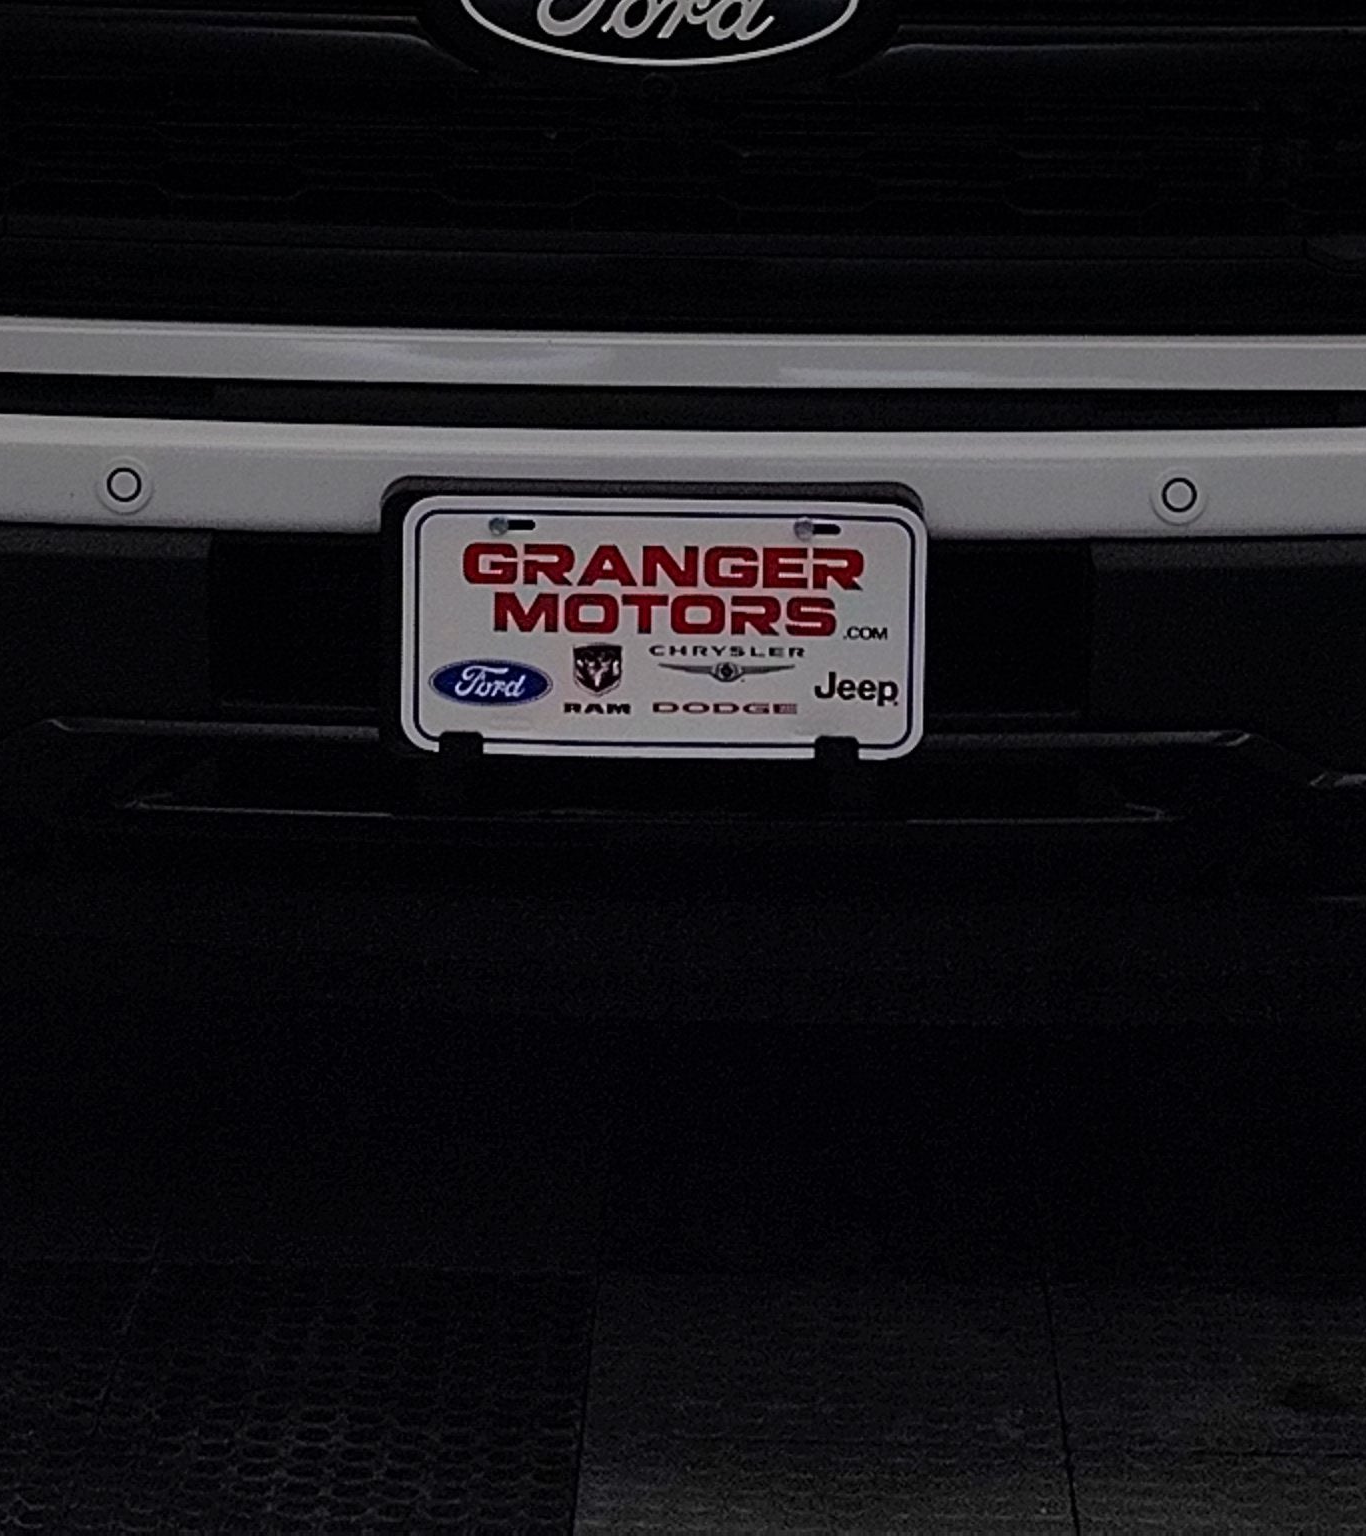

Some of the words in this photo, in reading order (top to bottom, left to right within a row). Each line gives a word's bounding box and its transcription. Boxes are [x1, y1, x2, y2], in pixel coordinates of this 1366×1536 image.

[462, 542, 865, 590] GRANGER
[493, 591, 837, 636] MOTORS
[843, 626, 888, 641] .COM
[648, 643, 805, 658] CHRYSLER
[454, 666, 525, 698] Ford
[814, 672, 899, 705] Jeep
[563, 702, 632, 715] RAM
[652, 702, 798, 715] DODGE
